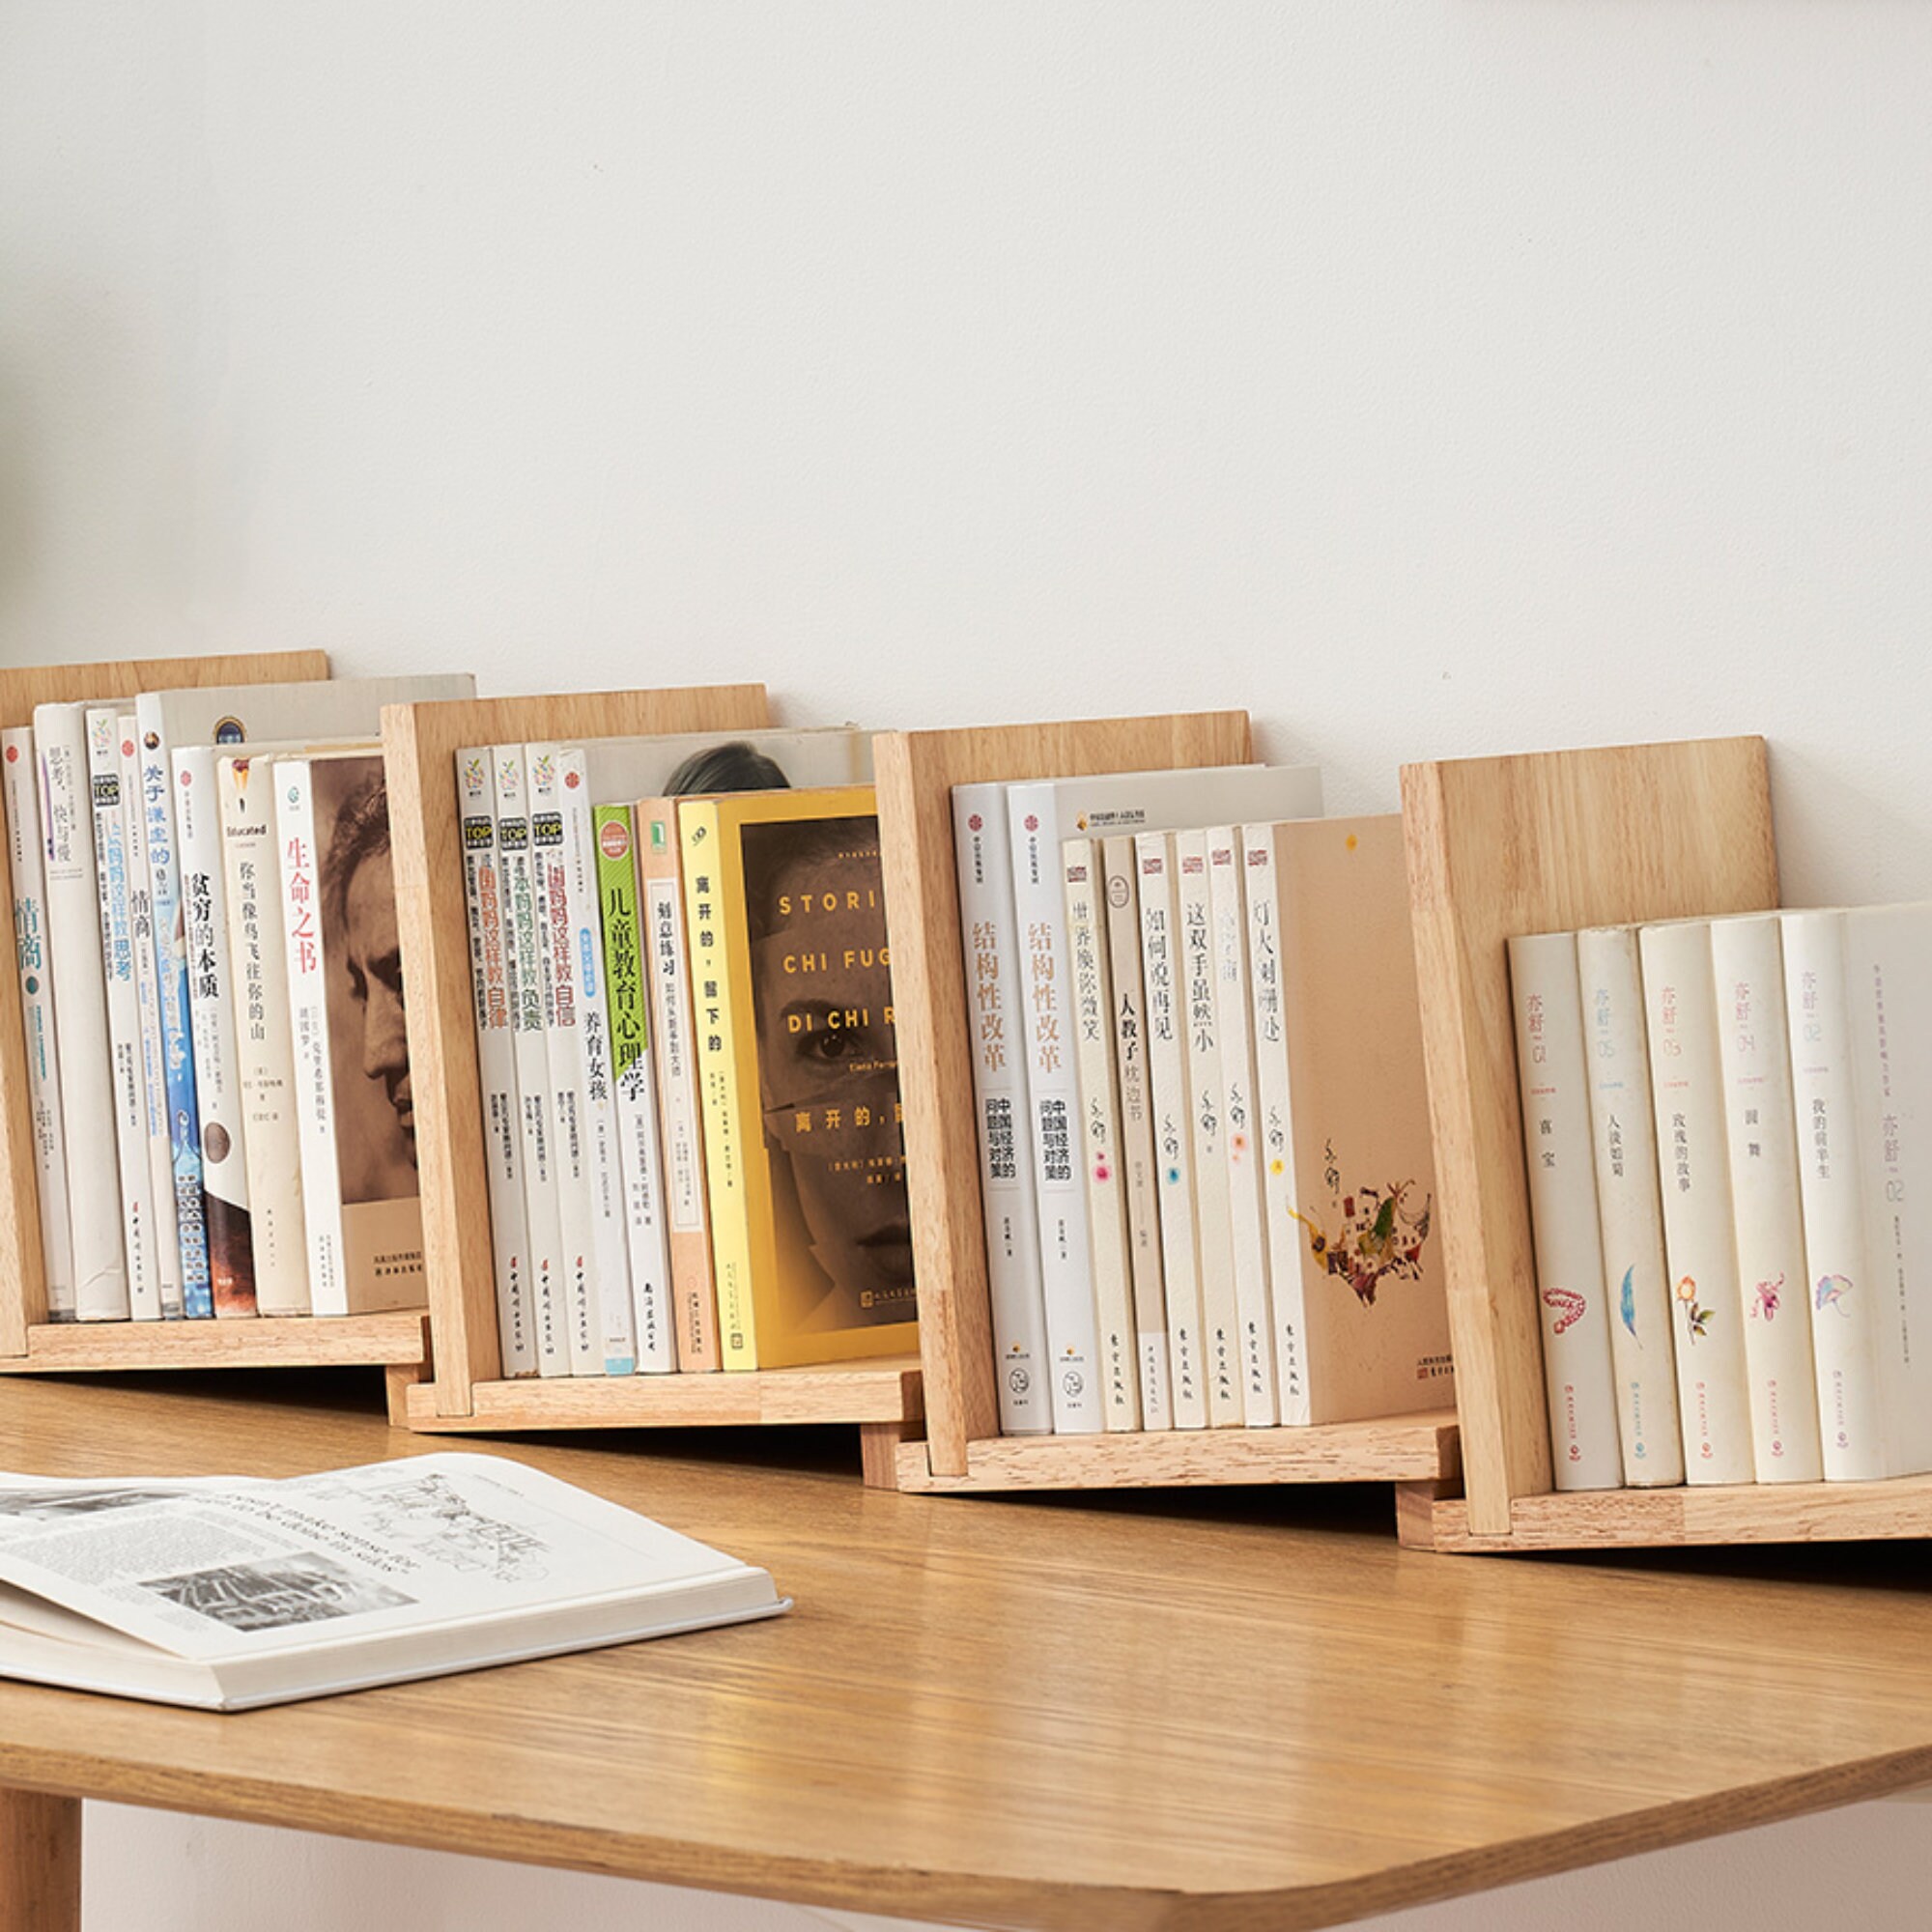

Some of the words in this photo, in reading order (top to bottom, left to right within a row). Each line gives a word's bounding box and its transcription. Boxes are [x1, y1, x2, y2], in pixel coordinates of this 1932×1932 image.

[466, 826, 492, 839] TOP
[501, 828, 526, 840] TOP
[535, 822, 561, 837] TOP
[14, 897, 42, 970] 情商
[192, 873, 219, 999] 贫穷的本质
[287, 837, 316, 974] 生命之书
[779, 891, 874, 915] STORI
[610, 888, 645, 1102] 儿童教育心理学
[782, 952, 827, 974] CHI
[972, 921, 1007, 1073] 结构性改革
[1027, 922, 1062, 1074] 结构性改革
[1186, 902, 1214, 1053] 这双手虽然小
[585, 1012, 609, 1101] 养育女孩
[787, 1013, 812, 1034] DI
[827, 1009, 868, 1030] CHI
[998, 1097, 1016, 1179] 中国经济的
[1053, 1099, 1072, 1180] 中国经济的
[1672, 1113, 1691, 1193] 玫瑰的故事
[1812, 1098, 1832, 1179] 我的前半生
